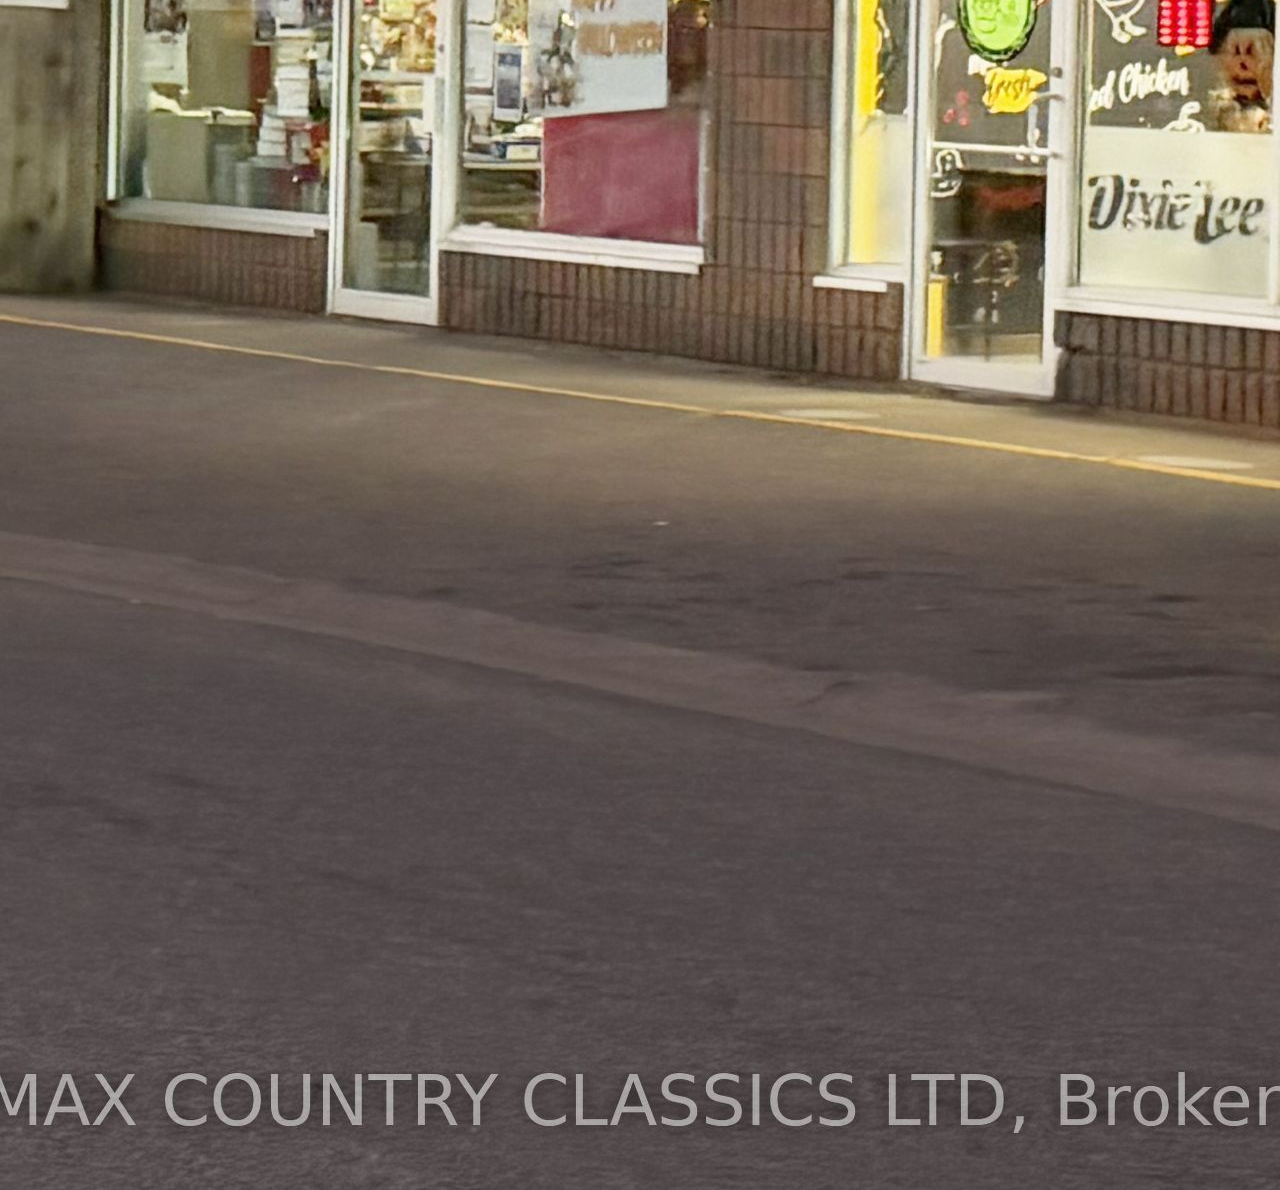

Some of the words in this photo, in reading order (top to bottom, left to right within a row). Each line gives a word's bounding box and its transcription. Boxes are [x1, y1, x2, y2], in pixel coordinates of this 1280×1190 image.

[1118, 57, 1190, 104] Chicken
[1088, 174, 1192, 231] Dixie
[1193, 180, 1265, 244] Lee
